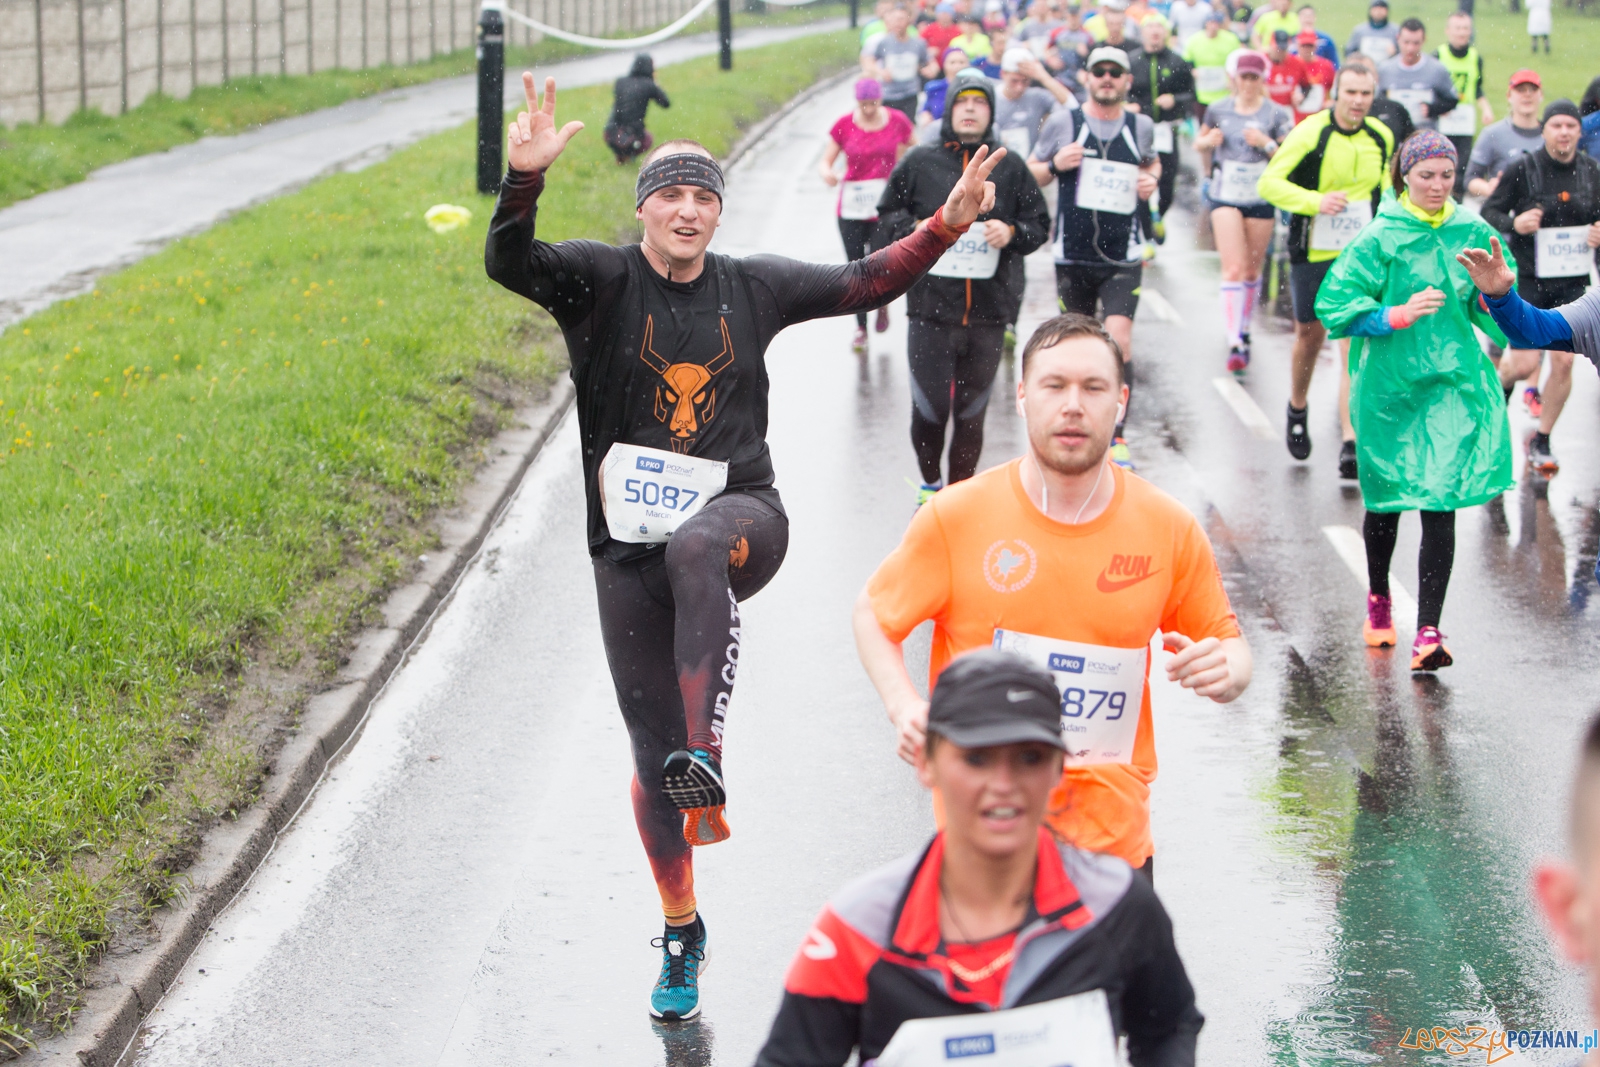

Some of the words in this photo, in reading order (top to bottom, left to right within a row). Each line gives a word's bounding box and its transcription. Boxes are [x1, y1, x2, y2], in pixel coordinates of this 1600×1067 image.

[1331, 217, 1361, 230] 1726
[946, 239, 989, 254] 094
[624, 478, 700, 512] 5087
[645, 509, 672, 520] Marcin
[1107, 553, 1153, 577] RUN
[1060, 721, 1088, 733] Adam
